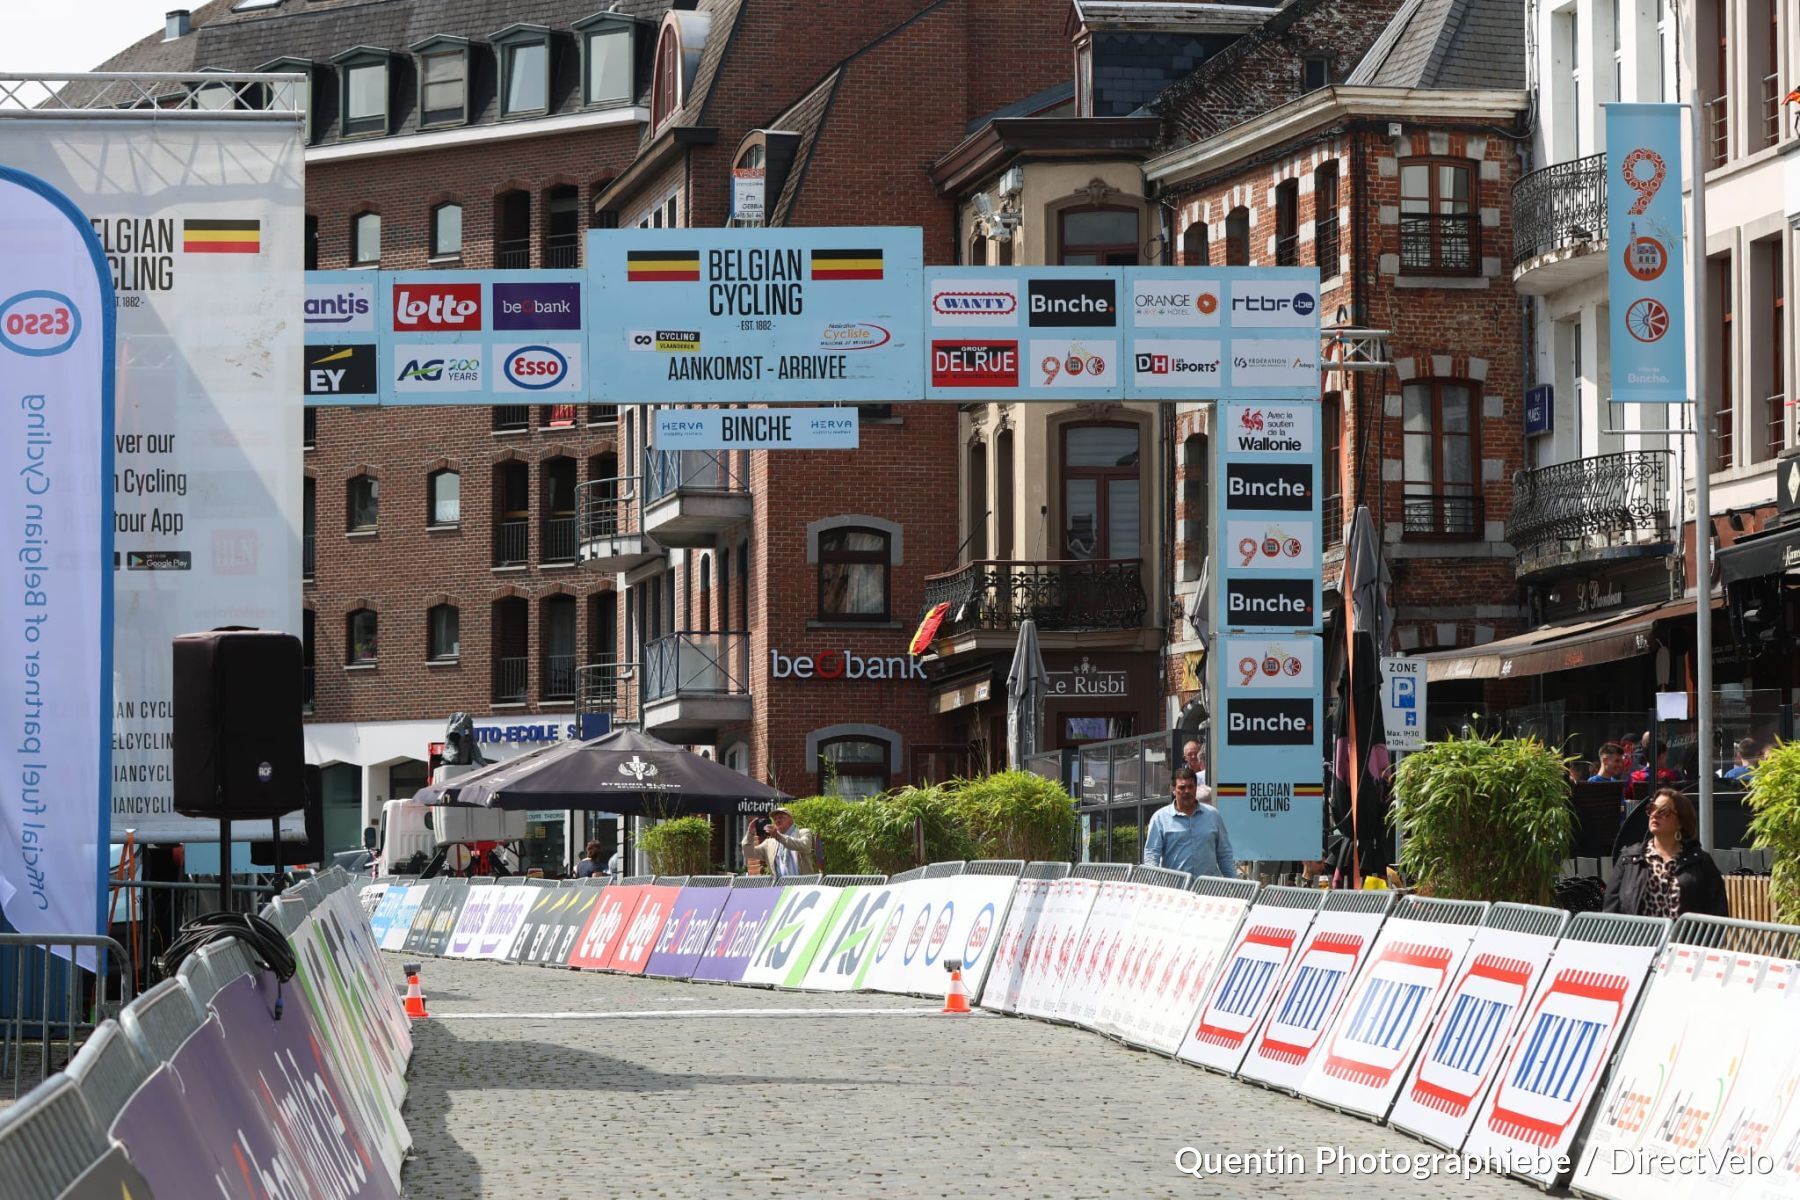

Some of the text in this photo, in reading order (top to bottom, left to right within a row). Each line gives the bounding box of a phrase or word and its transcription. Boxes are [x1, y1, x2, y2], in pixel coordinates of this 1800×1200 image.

[108, 256, 174, 291] CLING
[709, 249, 802, 281] BELGIAN
[304, 293, 369, 315] antis
[709, 283, 803, 316] CYCLING
[944, 298, 1006, 309] WANTY
[1135, 294, 1190, 307] ORANGE
[659, 332, 695, 341] CYCLING
[824, 328, 870, 340] Cycliste
[397, 359, 444, 381] AG
[668, 356, 763, 381] AANKOMST
[778, 355, 847, 380] ARRIVEE
[936, 351, 1015, 372] DELRUE
[1137, 354, 1167, 373] DH
[310, 368, 346, 391] EY
[448, 372, 478, 381] YEARS
[1267, 411, 1285, 419] Avec
[662, 422, 703, 431] HERVA
[722, 416, 791, 441] BINCHE
[811, 420, 852, 428] HERVA
[1267, 420, 1294, 428] soutien
[147, 434, 175, 453] our
[1239, 437, 1301, 451] Wallonie
[124, 469, 187, 496] Cycling
[151, 508, 184, 536] App
[146, 559, 188, 568] Google Play
[1389, 663, 1418, 672] ZONE
[1075, 676, 1125, 693] Rusbi
[1394, 678, 1414, 707] P
[1250, 783, 1290, 797] BELGIAN
[1250, 798, 1290, 812] CYCLING
